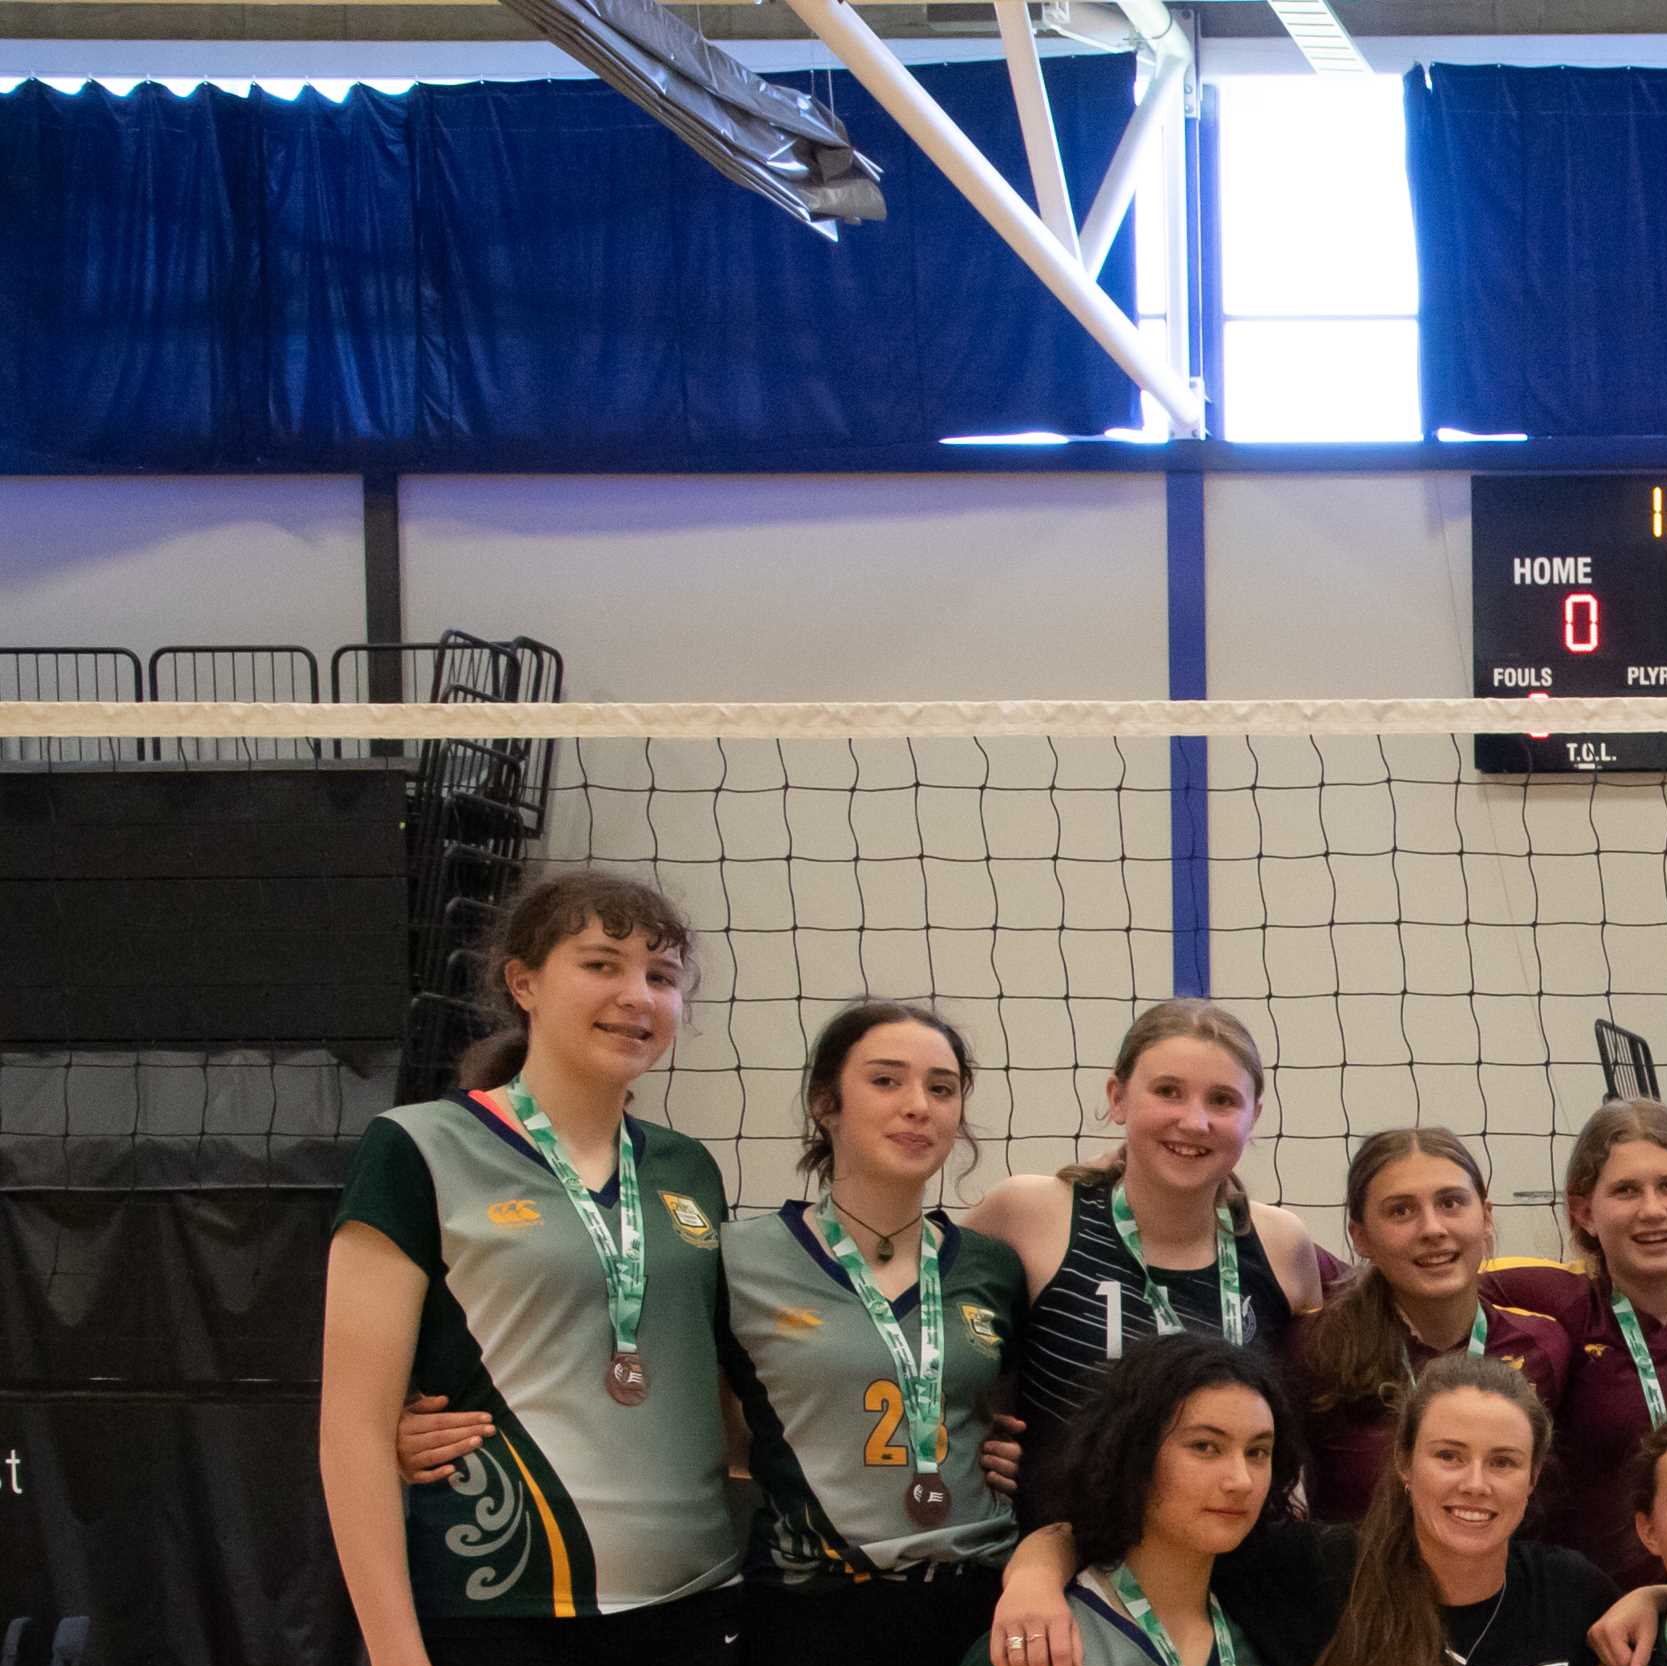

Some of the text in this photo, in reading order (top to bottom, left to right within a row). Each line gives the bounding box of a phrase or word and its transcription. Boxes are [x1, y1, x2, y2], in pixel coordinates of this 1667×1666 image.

[1513, 556, 1593, 585] HOME
[1564, 592, 1599, 653] 0
[1493, 667, 1552, 688] FOULS
[1566, 743, 1617, 763] T.O.L.
